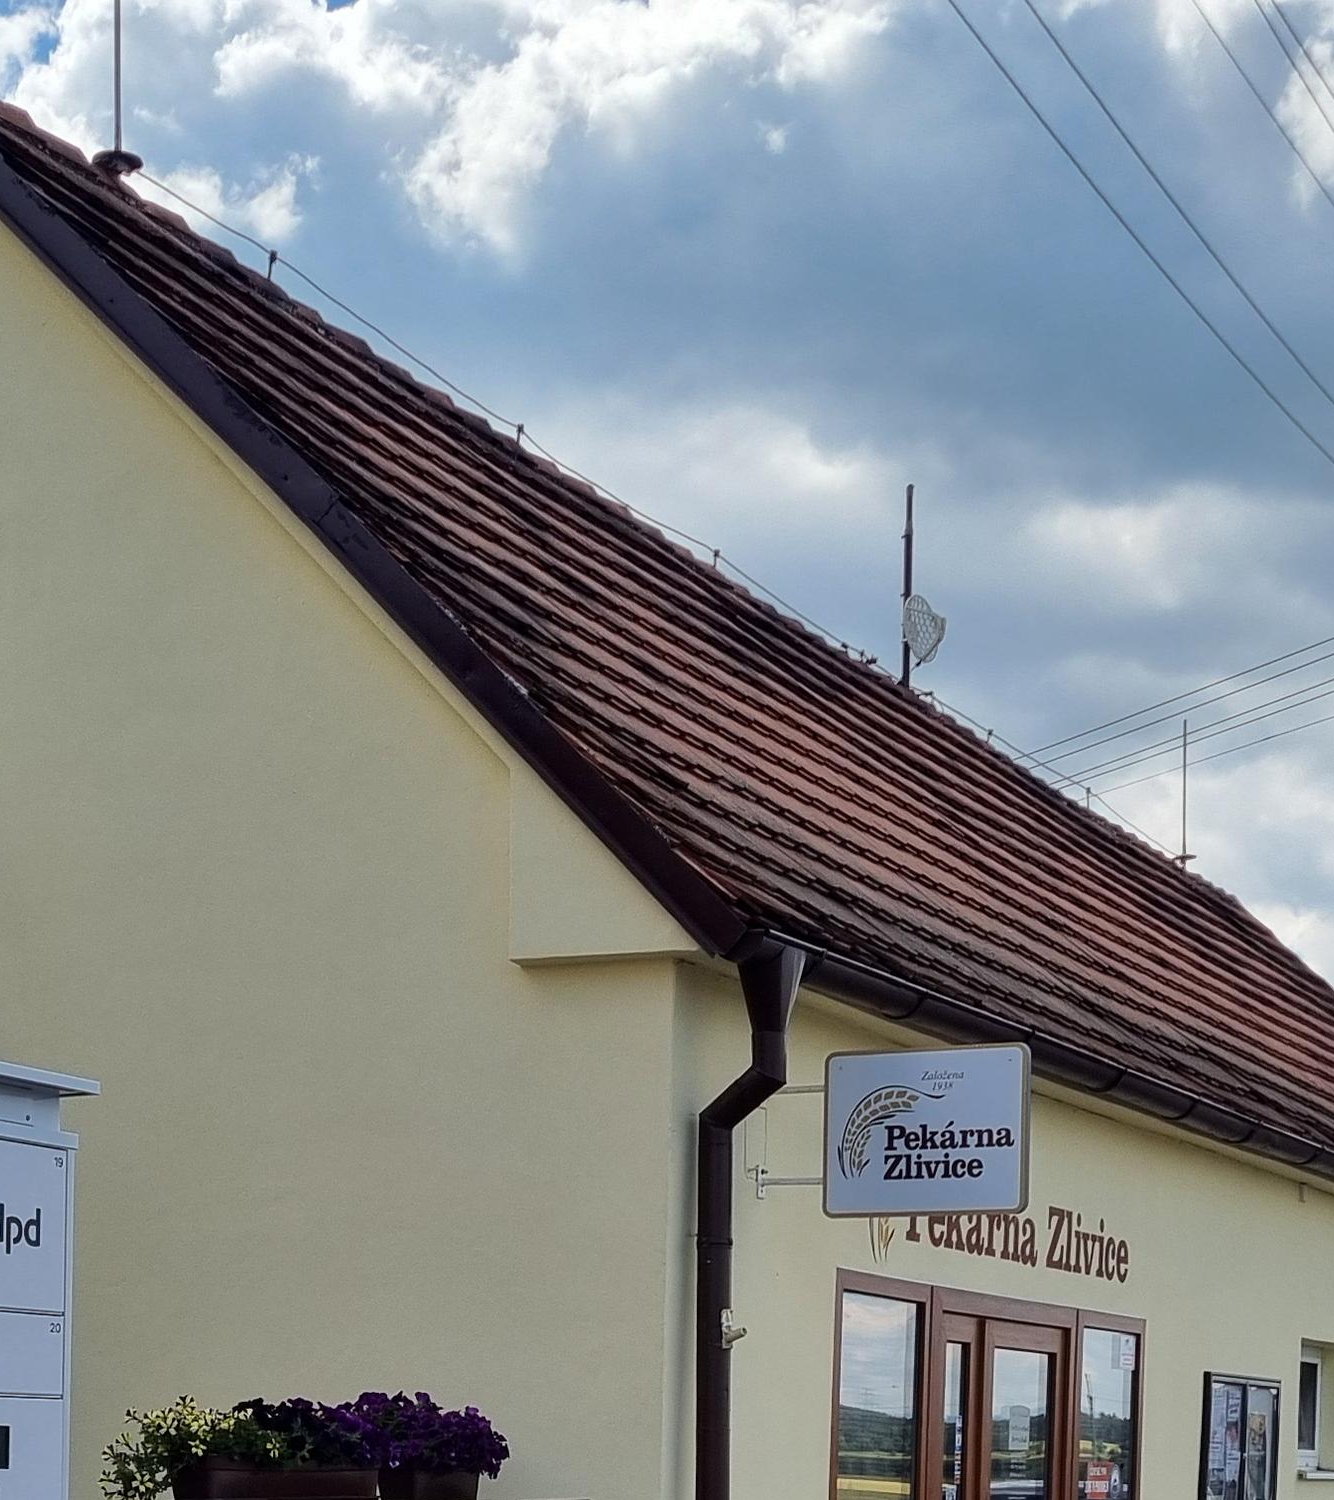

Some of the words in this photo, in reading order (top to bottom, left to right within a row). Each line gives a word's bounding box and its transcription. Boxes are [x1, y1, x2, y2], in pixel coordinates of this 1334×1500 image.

[884, 1121, 1015, 1152] Pekárna
[54, 1157, 64, 1168] 19
[883, 1153, 984, 1180] Zlivice
[1045, 1206, 1129, 1284] Zlivice
[50, 1322, 62, 1334] 20
